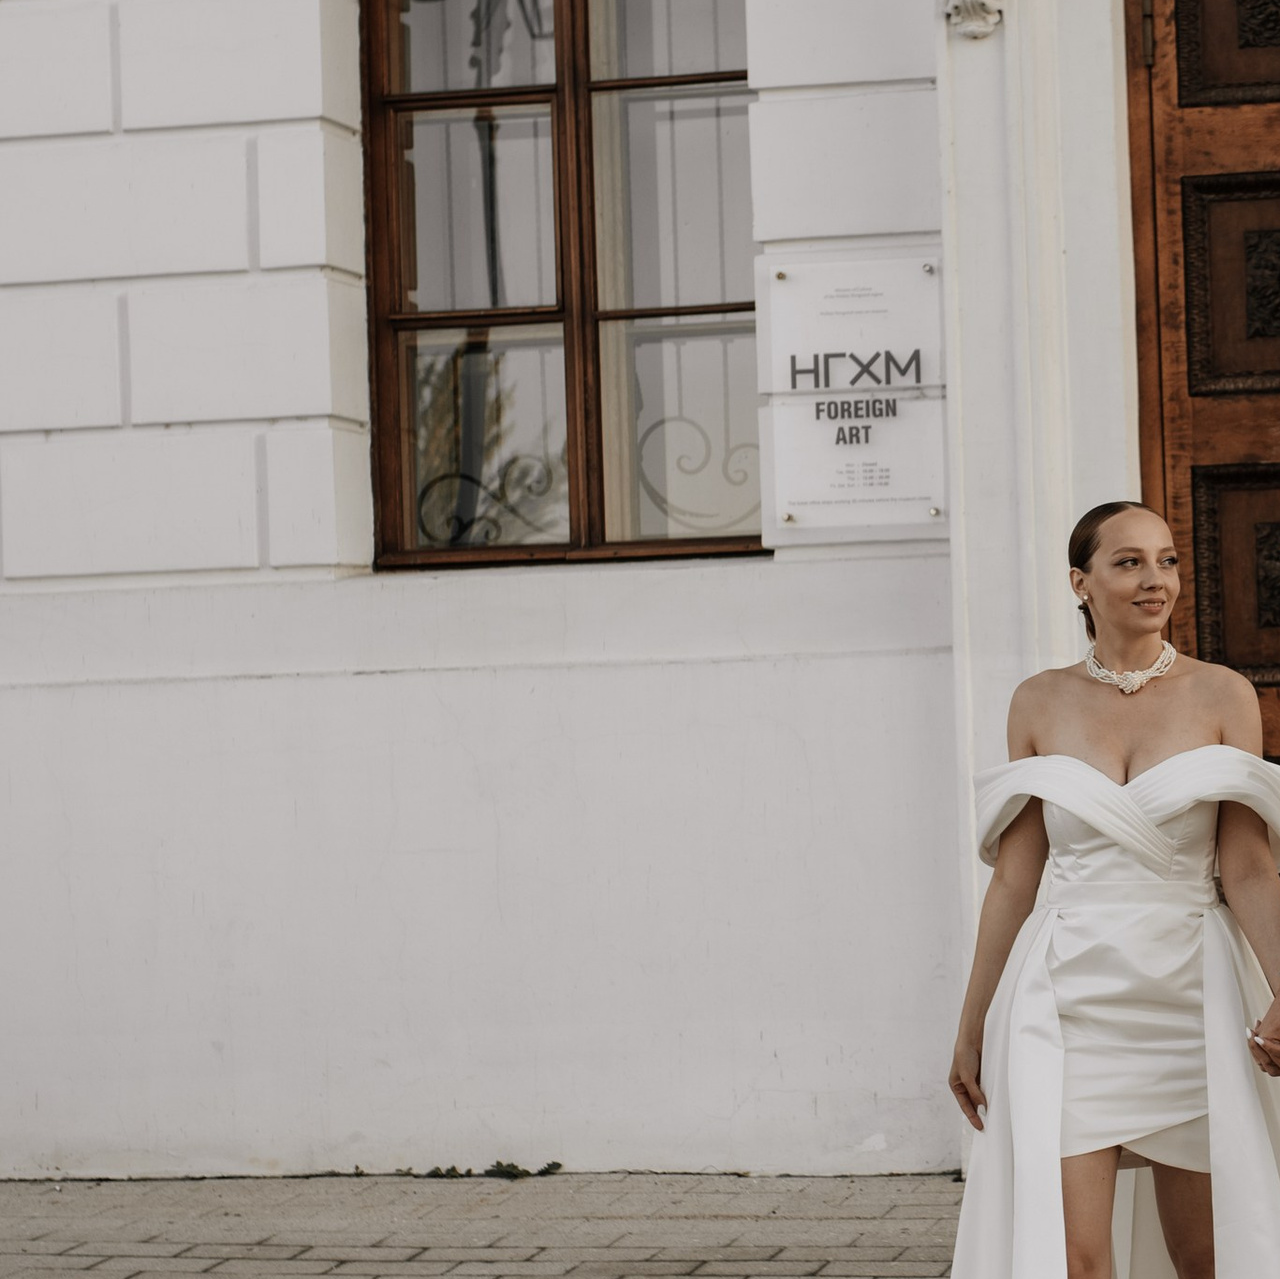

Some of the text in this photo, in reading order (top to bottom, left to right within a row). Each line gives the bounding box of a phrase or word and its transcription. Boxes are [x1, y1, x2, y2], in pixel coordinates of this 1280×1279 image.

[790, 348, 922, 390] НГХМ
[815, 398, 898, 421] FOREIGN
[835, 425, 873, 446] ART
